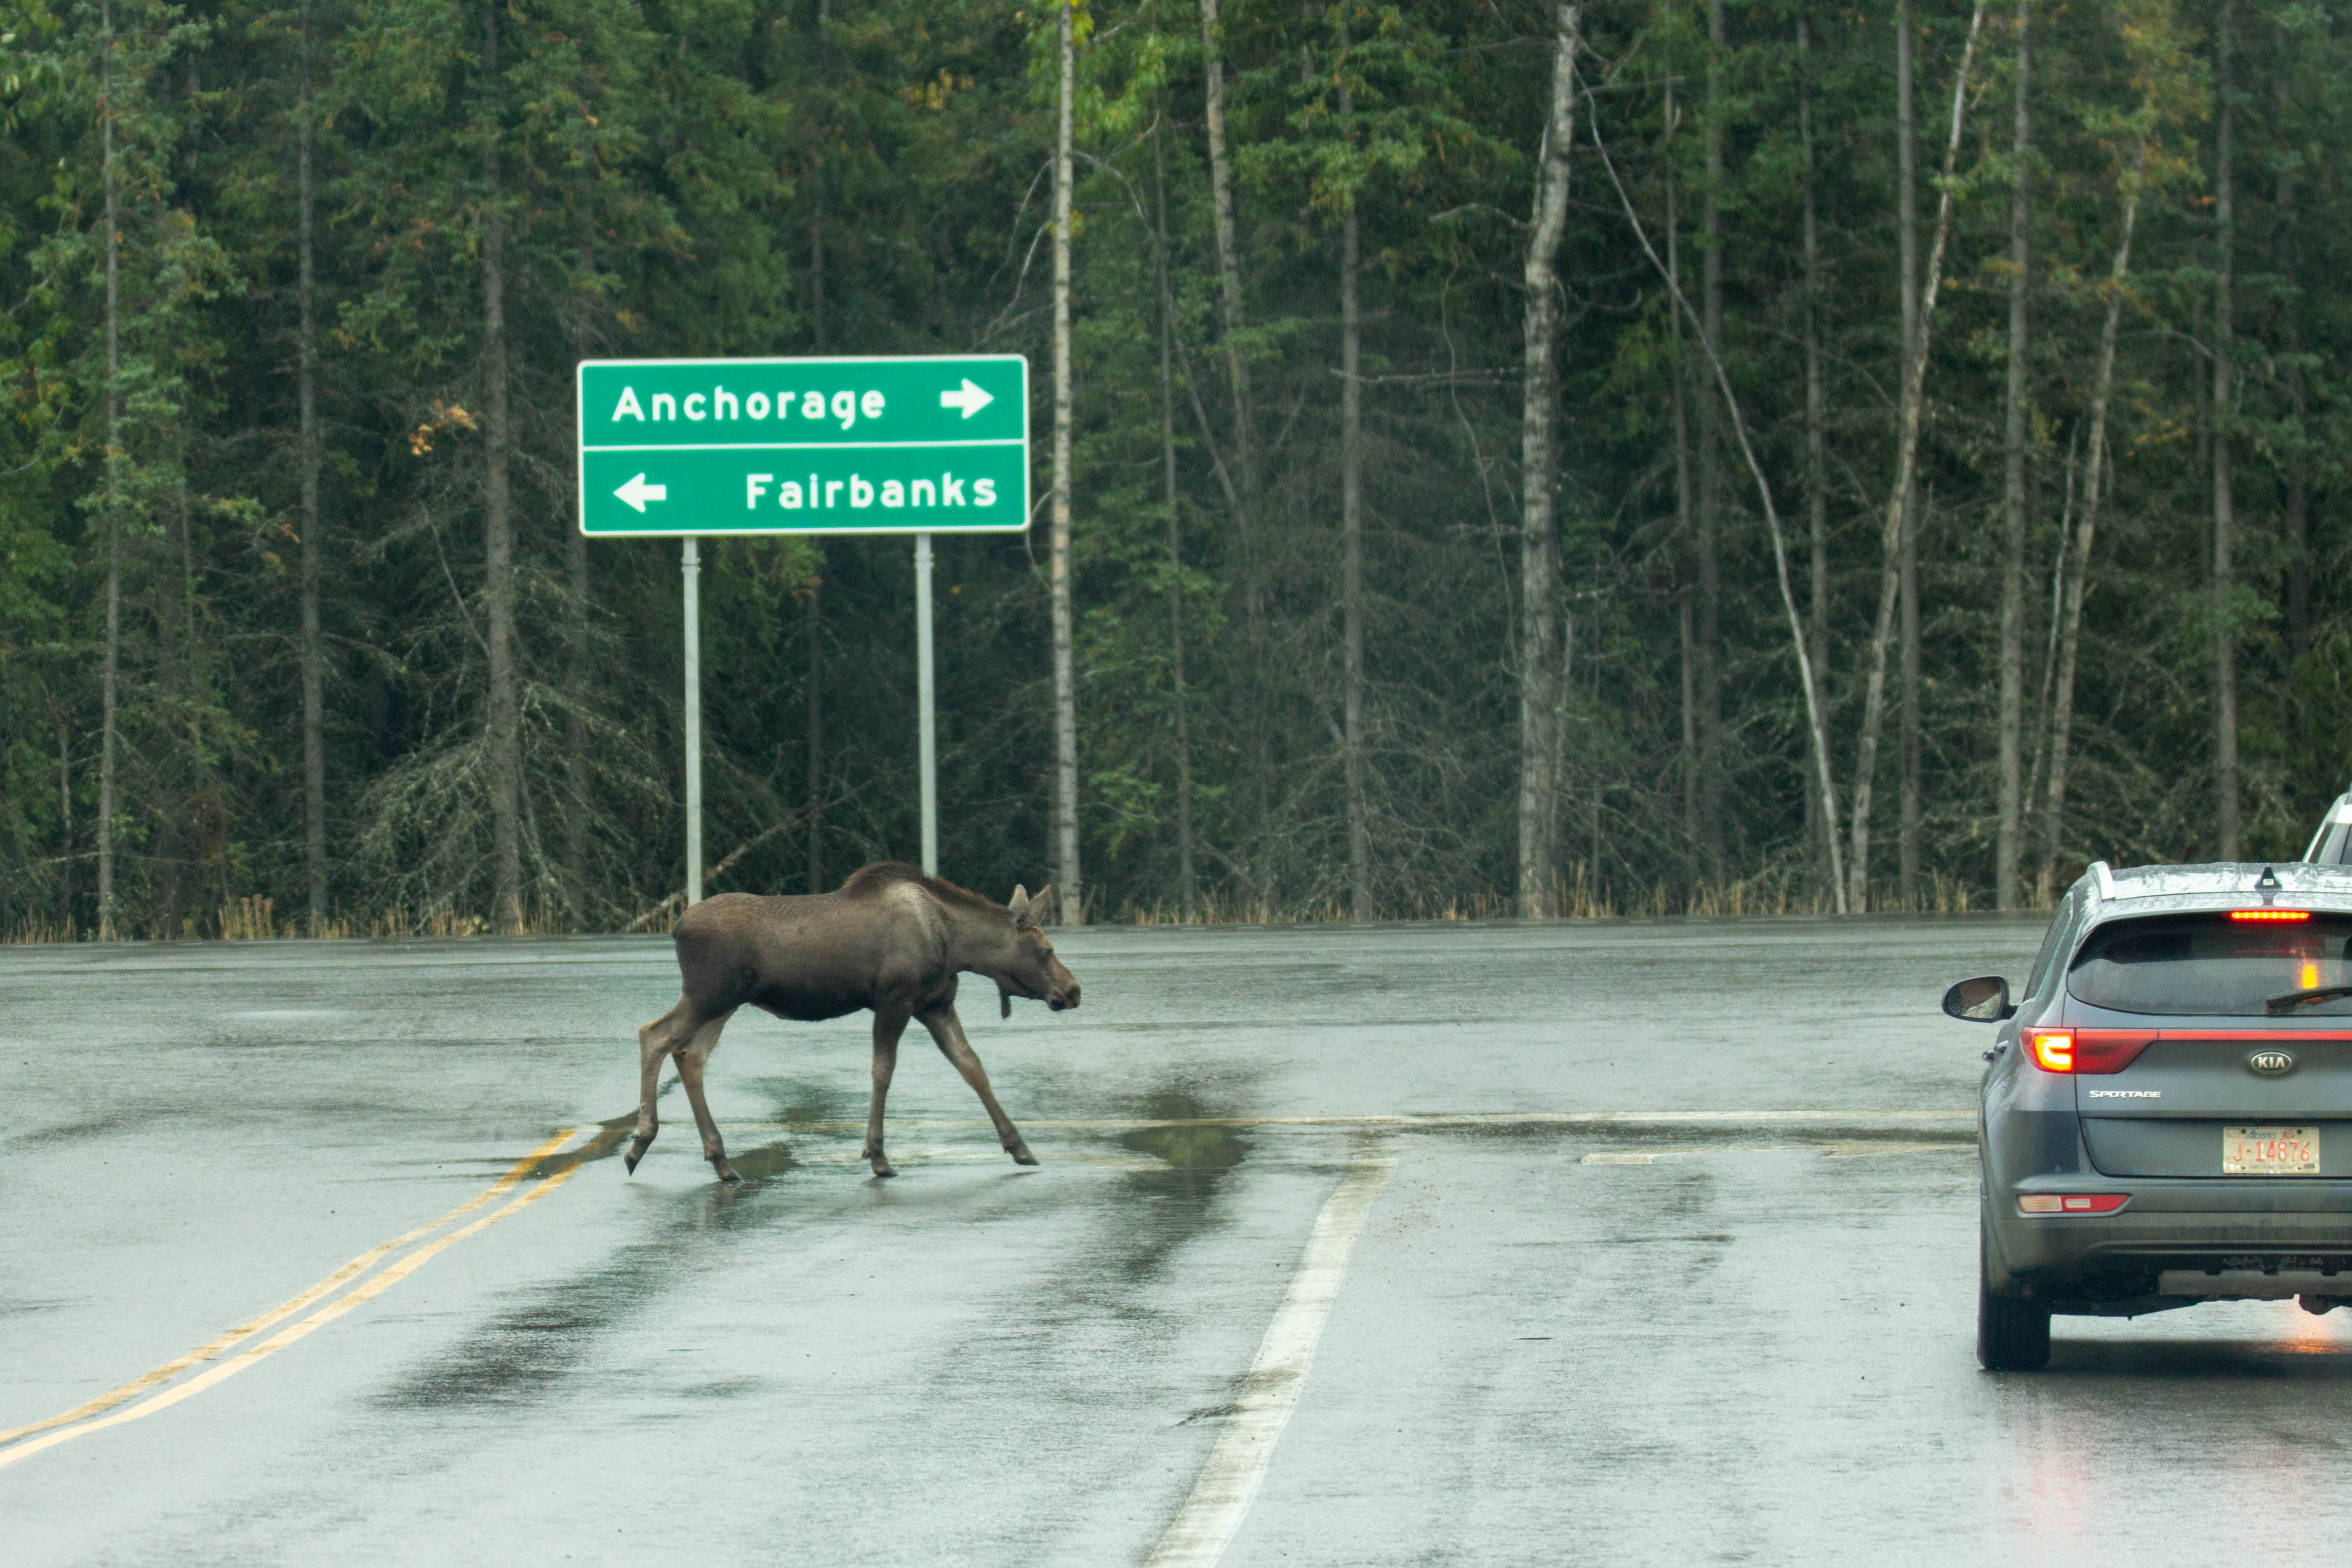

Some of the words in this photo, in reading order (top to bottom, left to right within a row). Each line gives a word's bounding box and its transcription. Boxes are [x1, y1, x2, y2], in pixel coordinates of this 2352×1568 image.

[611, 385, 886, 430] Anchorage
[746, 472, 997, 509] Fairbanks
[2258, 1056, 2286, 1069] KIA
[2233, 1140, 2310, 1162] J-14876
